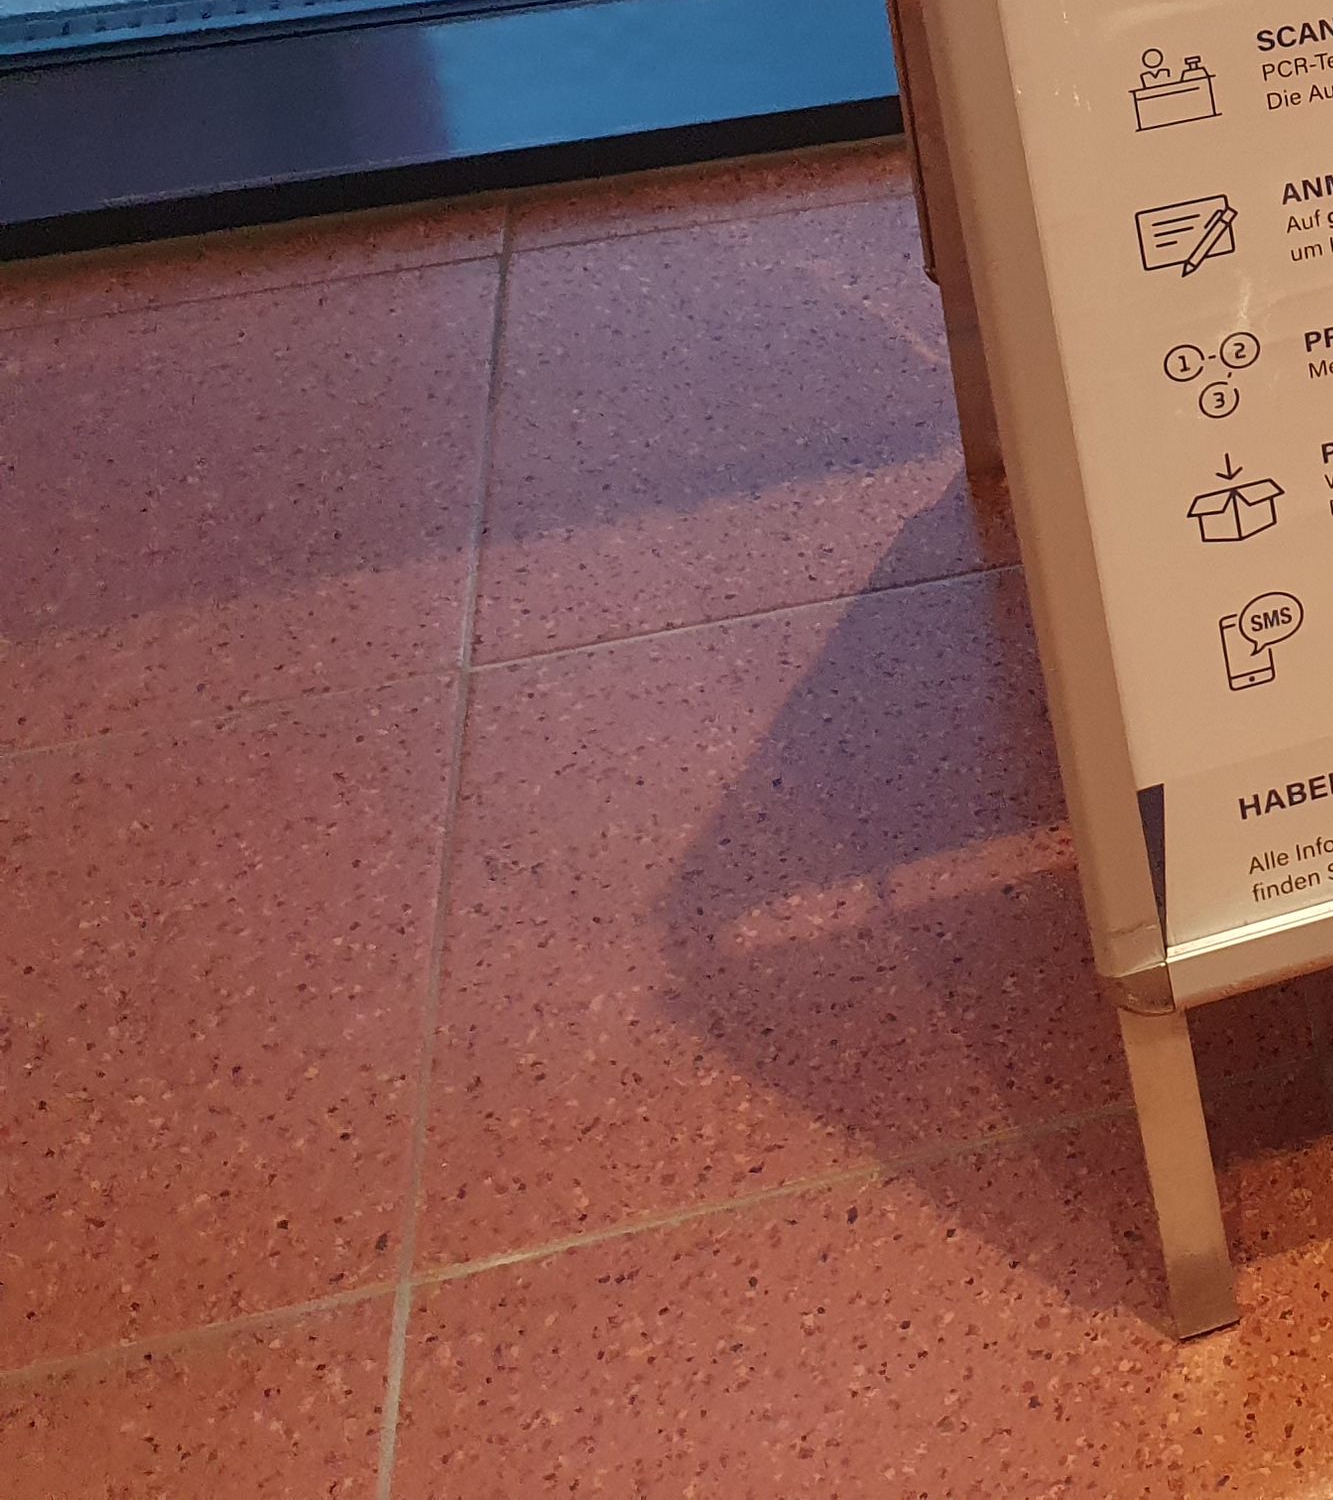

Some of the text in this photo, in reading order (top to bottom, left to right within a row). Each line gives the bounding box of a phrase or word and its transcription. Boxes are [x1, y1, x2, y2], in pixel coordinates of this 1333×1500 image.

[1291, 244, 1322, 261] um
[1233, 342, 1246, 359] 2
[1178, 355, 1191, 372] 1
[1213, 392, 1225, 409] 3
[1250, 606, 1293, 632] SMS
[1253, 873, 1320, 902] finden
